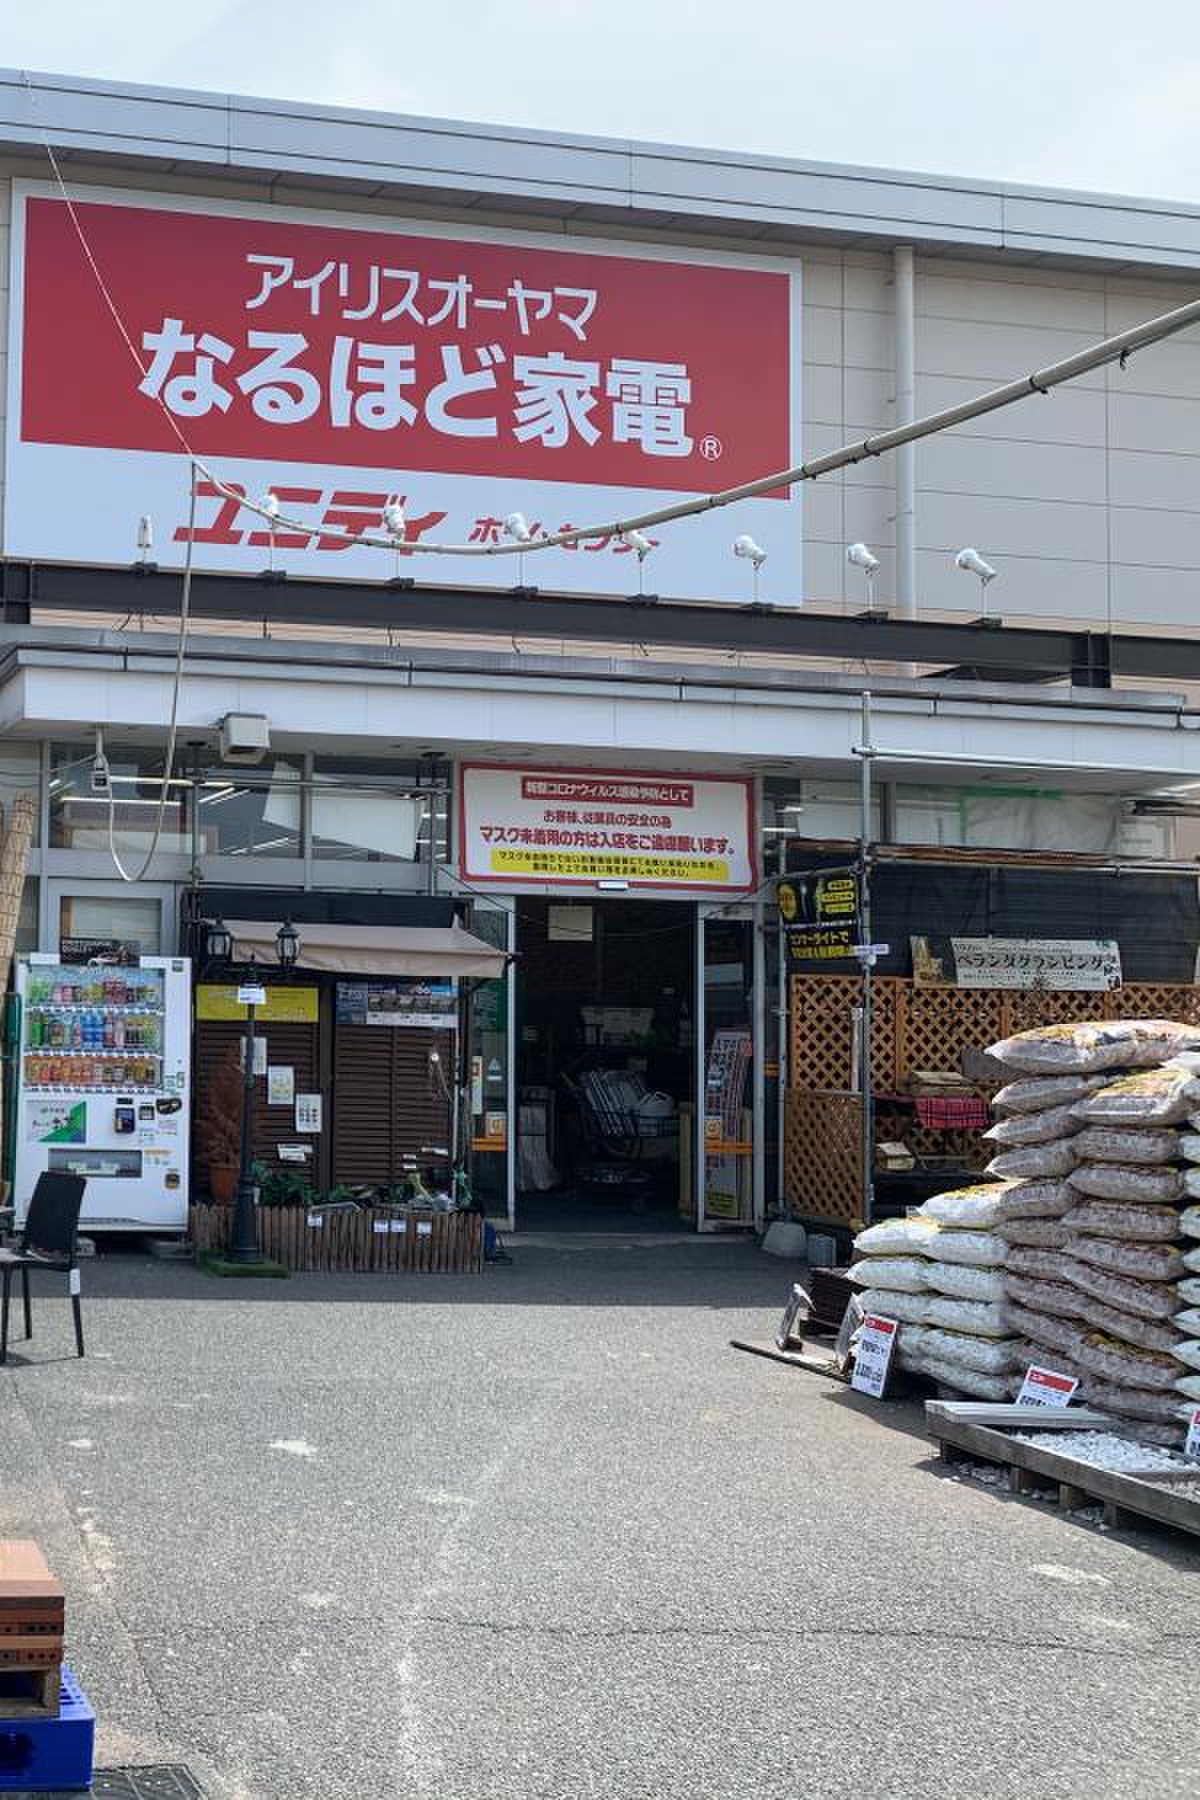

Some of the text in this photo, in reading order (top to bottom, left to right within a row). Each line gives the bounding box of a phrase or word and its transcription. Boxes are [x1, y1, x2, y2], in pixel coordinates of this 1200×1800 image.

[245, 253, 598, 341] アイリスオーヤマ
[138, 318, 695, 457] なるほど家電
